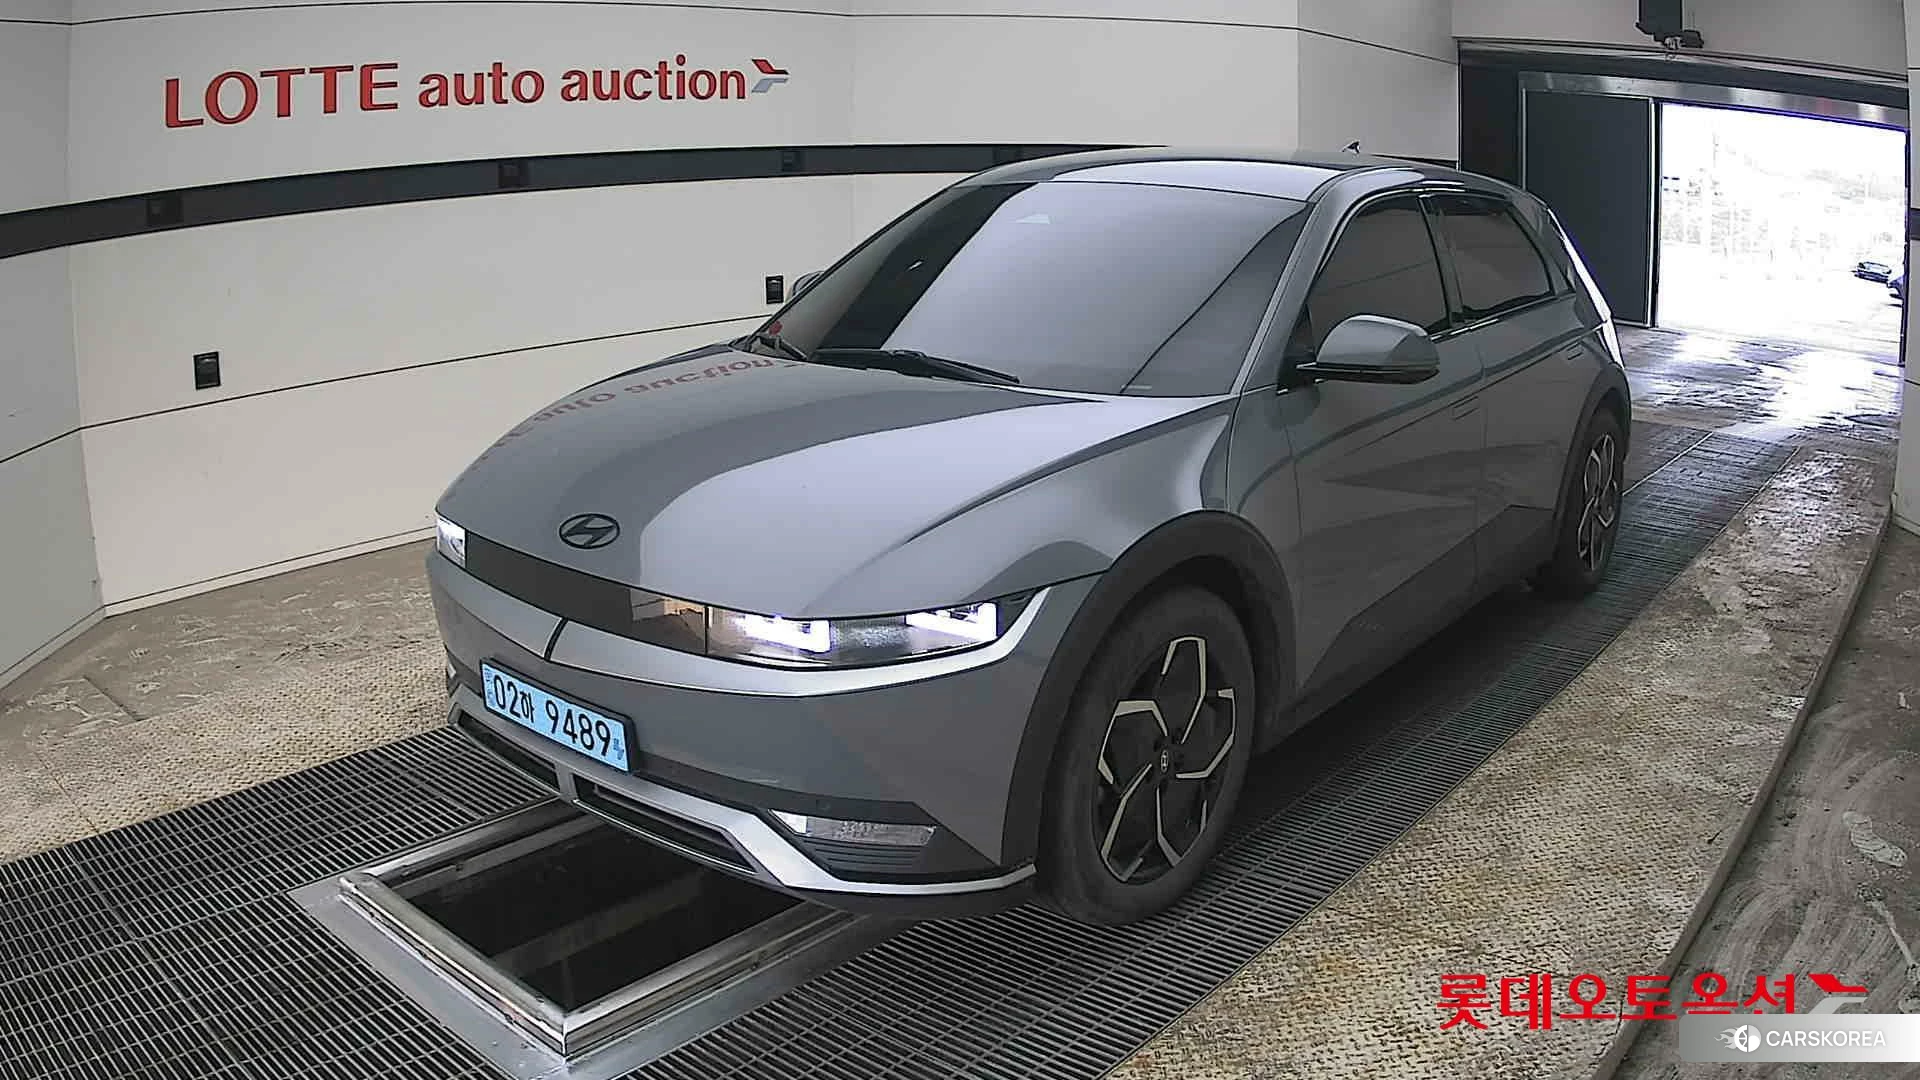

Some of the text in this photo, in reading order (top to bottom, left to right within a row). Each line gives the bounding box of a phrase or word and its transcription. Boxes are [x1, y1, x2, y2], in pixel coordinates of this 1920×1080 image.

[163, 54, 747, 129] LOTTE auto auction
[493, 673, 535, 723] 02하
[545, 699, 612, 757] 9489
